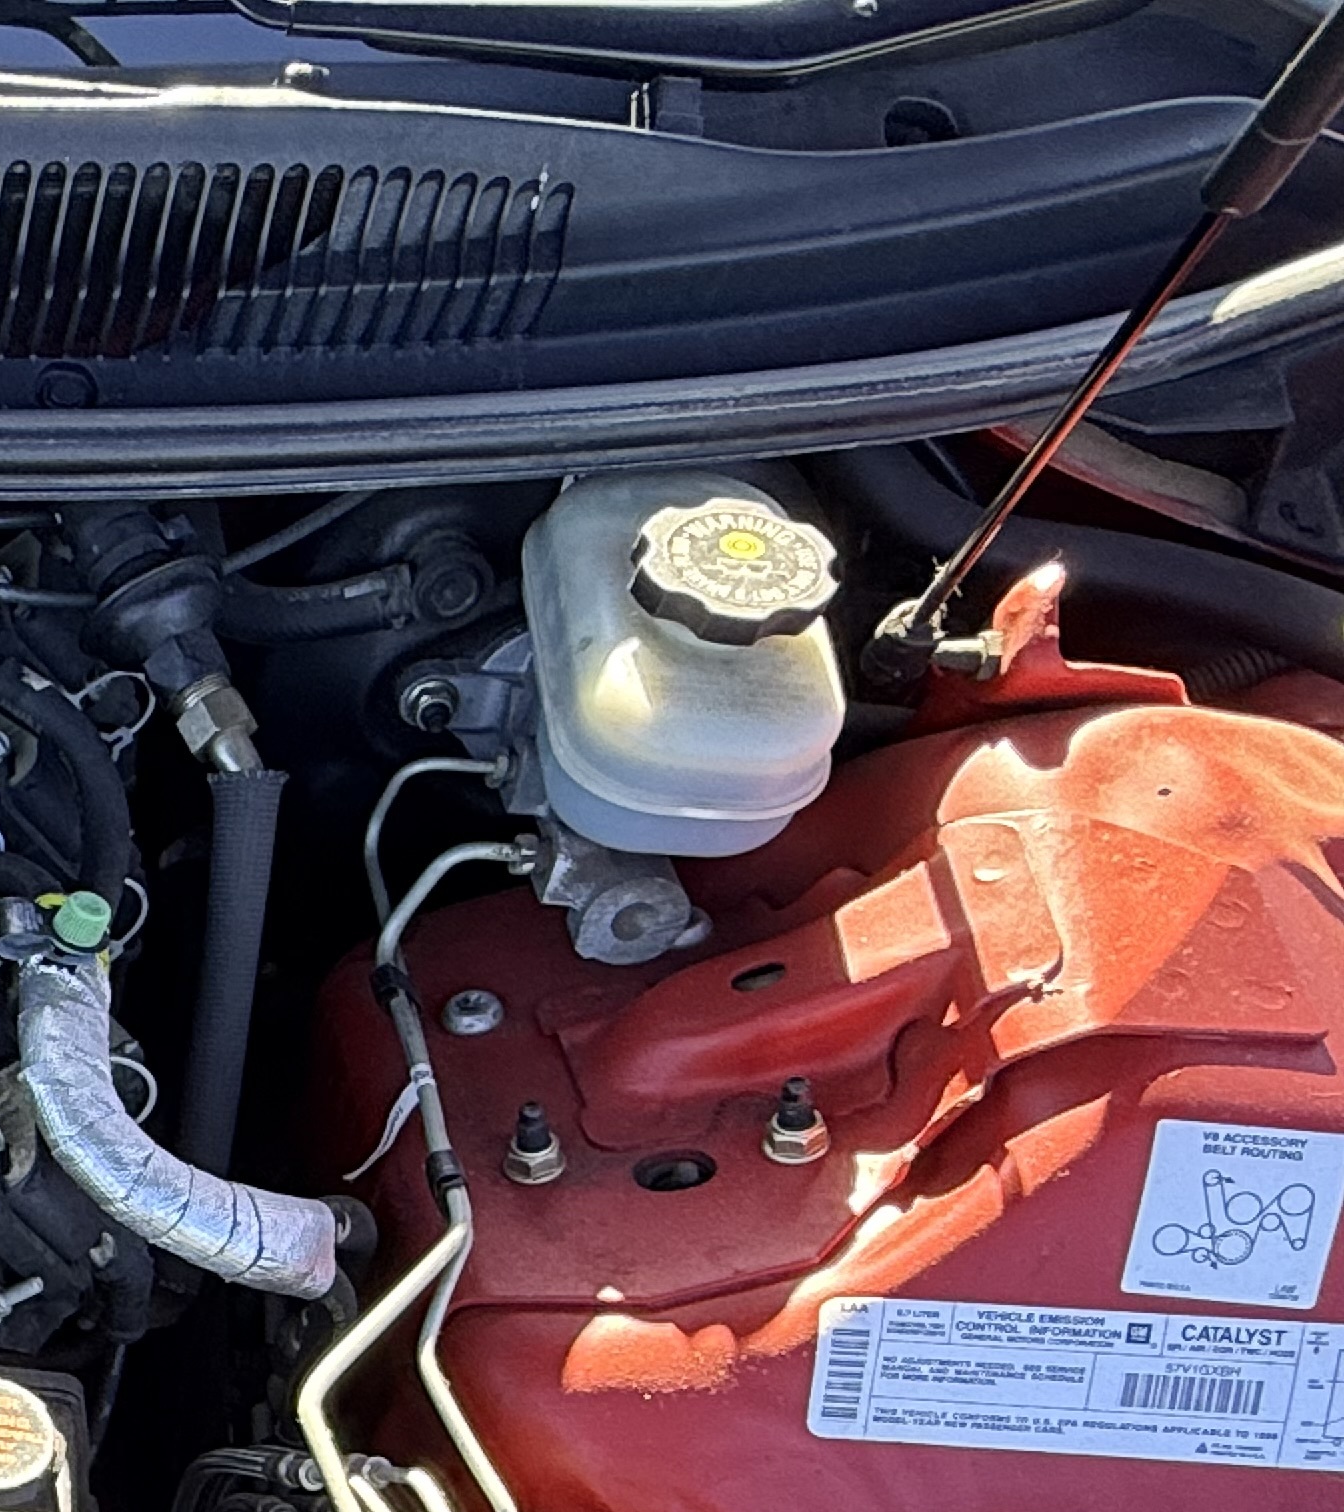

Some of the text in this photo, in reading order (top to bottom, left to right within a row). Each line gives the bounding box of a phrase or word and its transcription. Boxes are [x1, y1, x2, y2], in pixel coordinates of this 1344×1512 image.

[1223, 1132, 1307, 1149] ACCESSORY
[976, 1310, 1035, 1322] VEHICLE
[954, 1320, 1022, 1334] CONTROL
[1028, 1324, 1121, 1340] INFORMATION
[1181, 1324, 1287, 1347] CATALYST
